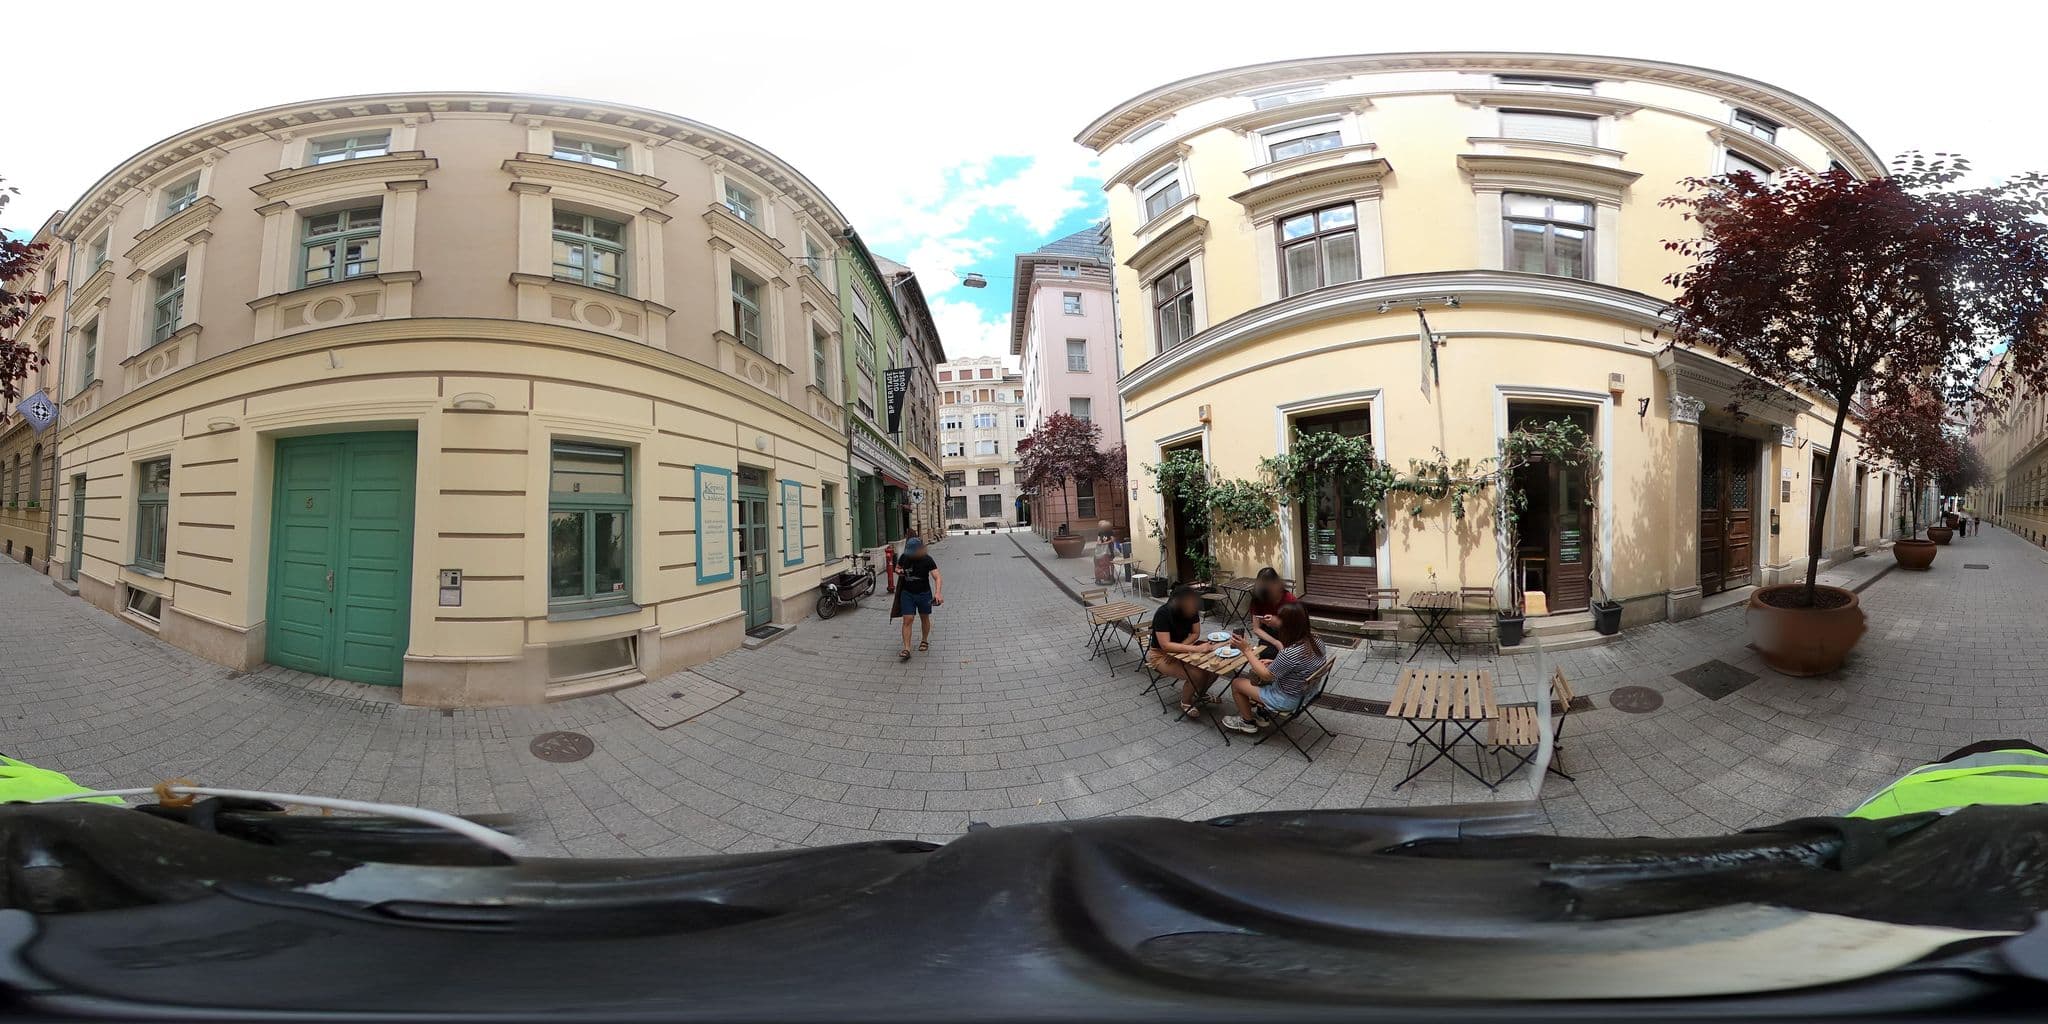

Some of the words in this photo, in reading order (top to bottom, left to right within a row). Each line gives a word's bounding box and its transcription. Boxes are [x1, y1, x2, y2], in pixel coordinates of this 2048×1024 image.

[886, 372, 895, 404] HERITAGE
[899, 370, 907, 392] HOUSE
[888, 404, 895, 415] BP
